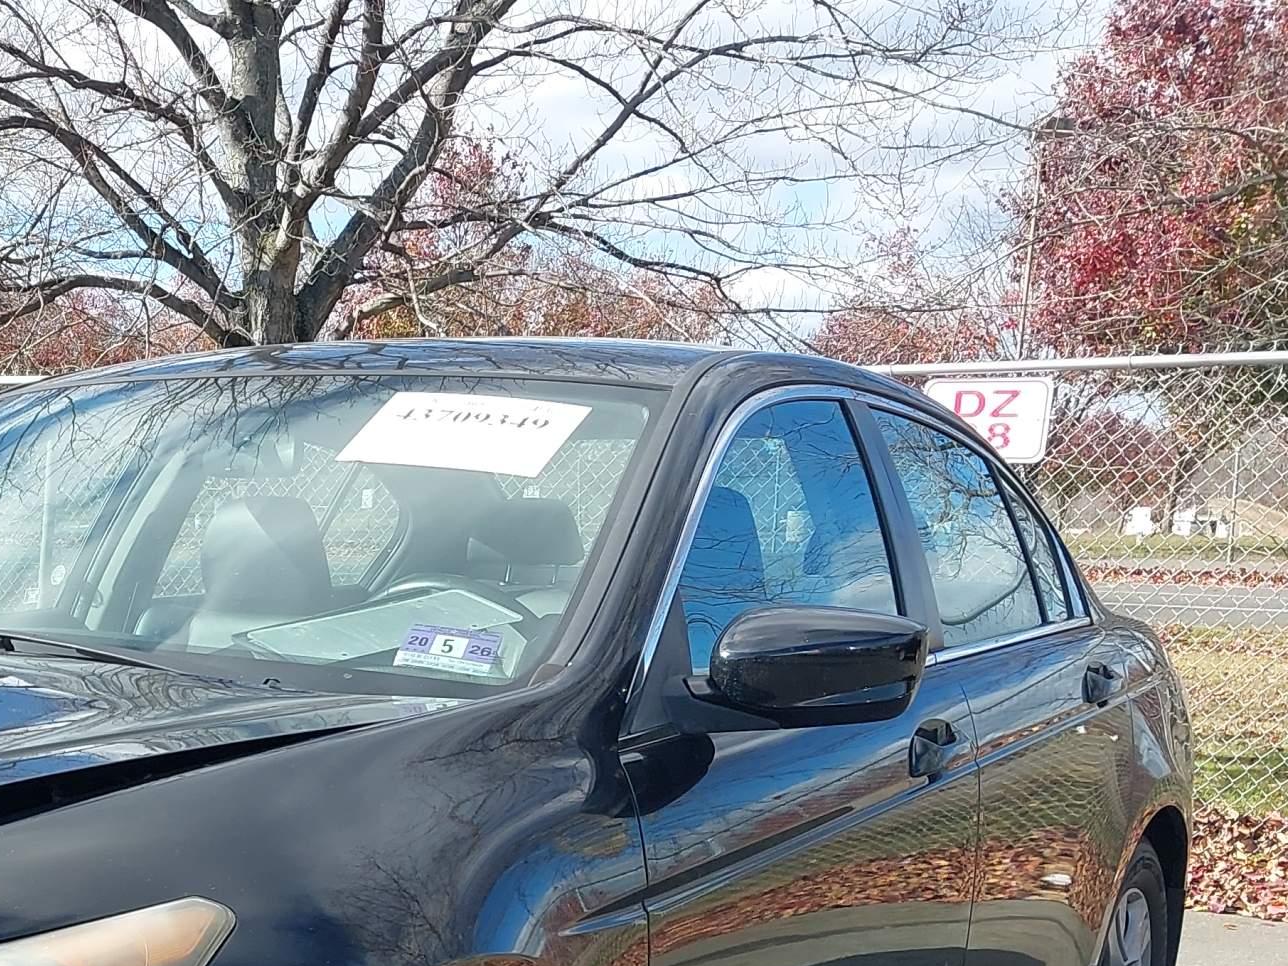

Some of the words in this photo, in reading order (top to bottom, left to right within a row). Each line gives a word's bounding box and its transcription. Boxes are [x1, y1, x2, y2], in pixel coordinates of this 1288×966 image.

[954, 390, 1021, 417] DZ
[968, 422, 1010, 449] 8
[407, 634, 429, 647] 20
[440, 638, 455, 654] 5
[469, 644, 492, 657] 26
